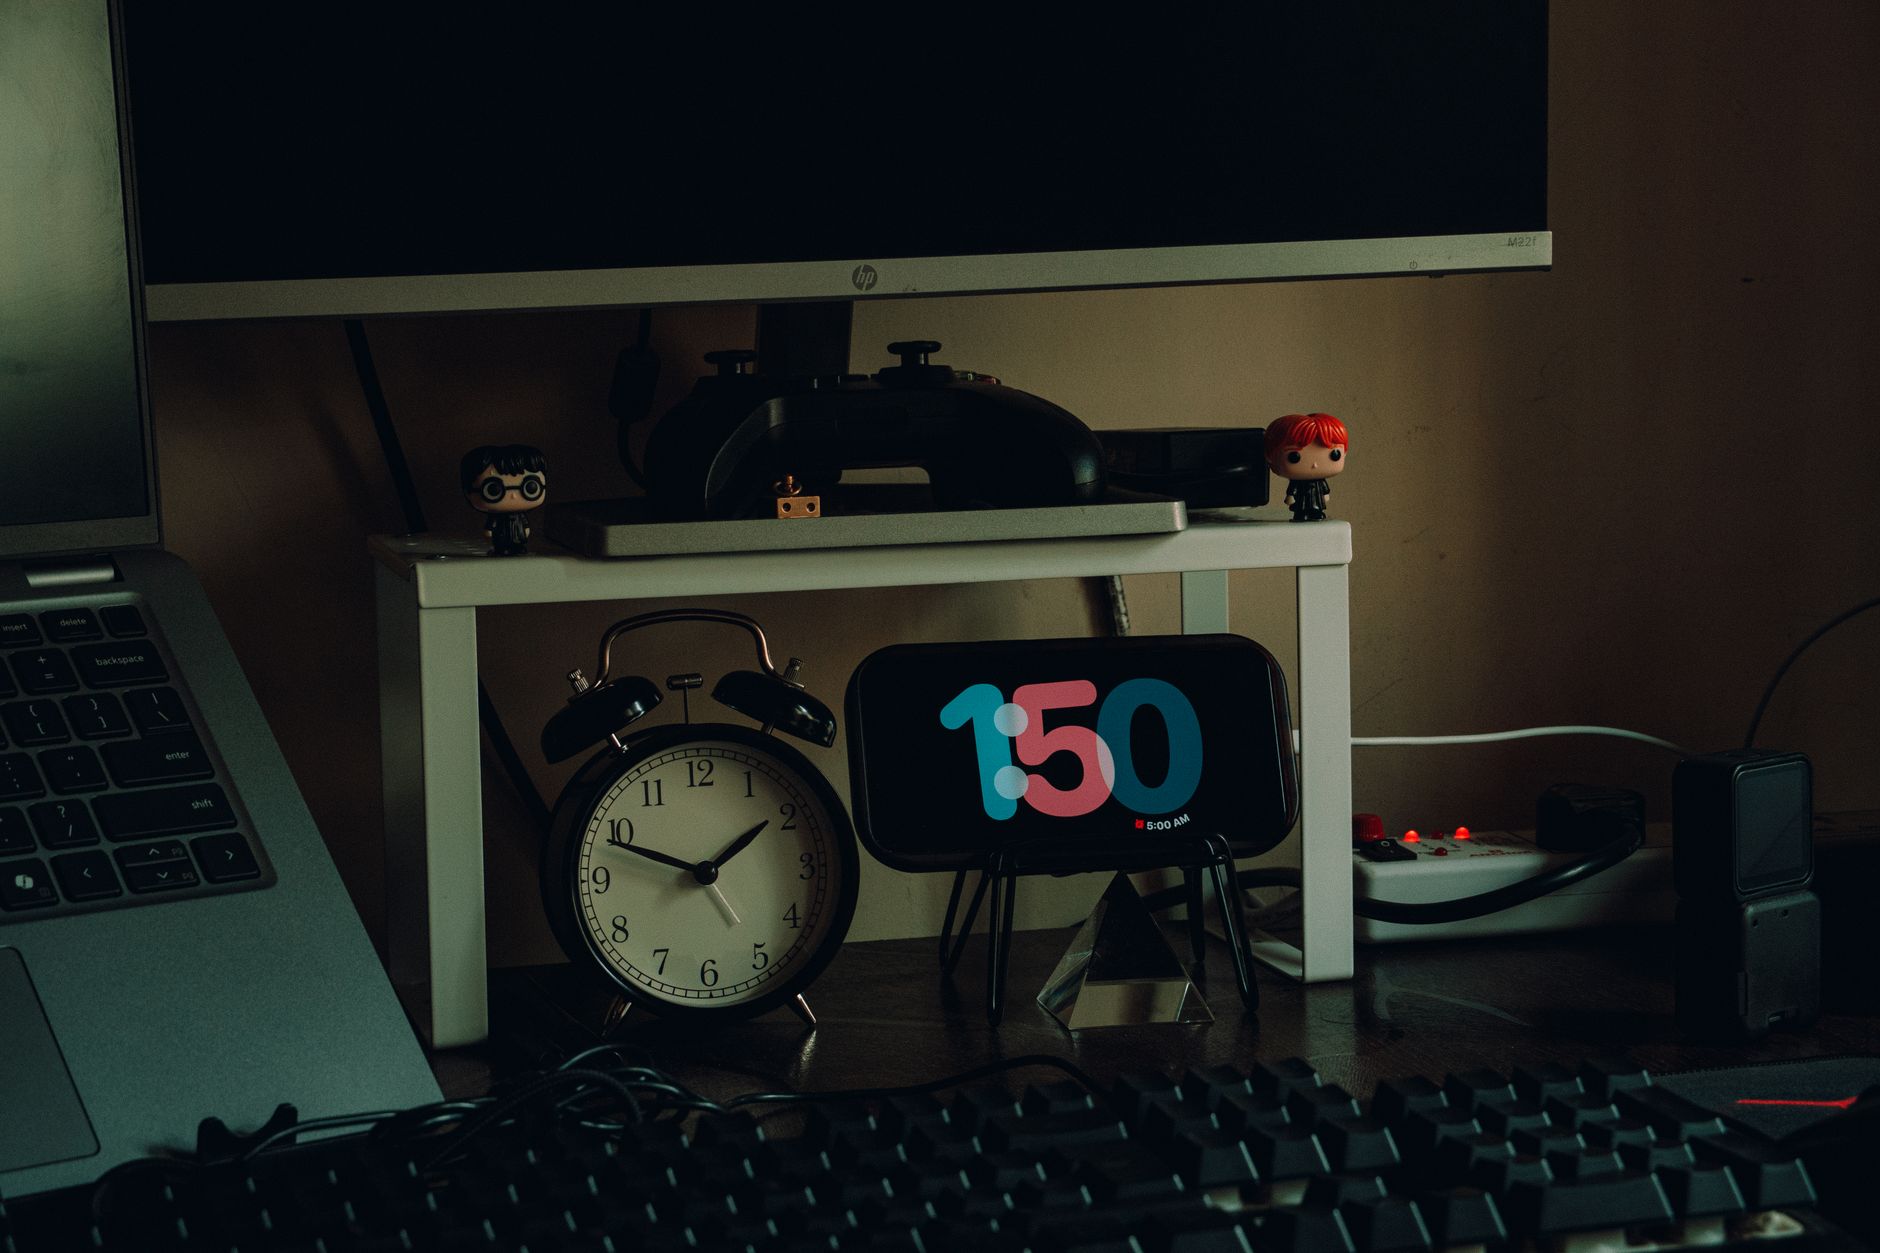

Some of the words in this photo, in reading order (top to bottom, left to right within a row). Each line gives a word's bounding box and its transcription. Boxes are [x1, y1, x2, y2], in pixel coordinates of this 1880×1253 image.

[1508, 237, 1537, 247] M22f
[1, 623, 28, 632] insert
[60, 617, 87, 626] delete
[95, 655, 145, 666] backspace
[165, 751, 191, 761] enter
[686, 759, 714, 788] 12
[743, 771, 756, 798] 1
[191, 799, 214, 810] shift
[641, 779, 665, 807] 11
[779, 803, 797, 831] 2
[1146, 820, 1172, 831] 5:00
[1173, 813, 1190, 828] AM
[607, 818, 634, 846] 10
[799, 853, 816, 880] 3
[592, 867, 611, 894] 9
[611, 916, 629, 943] 8
[783, 903, 801, 929] 4
[652, 948, 670, 975] 7
[752, 942, 769, 970] 5
[700, 959, 719, 987] 6
